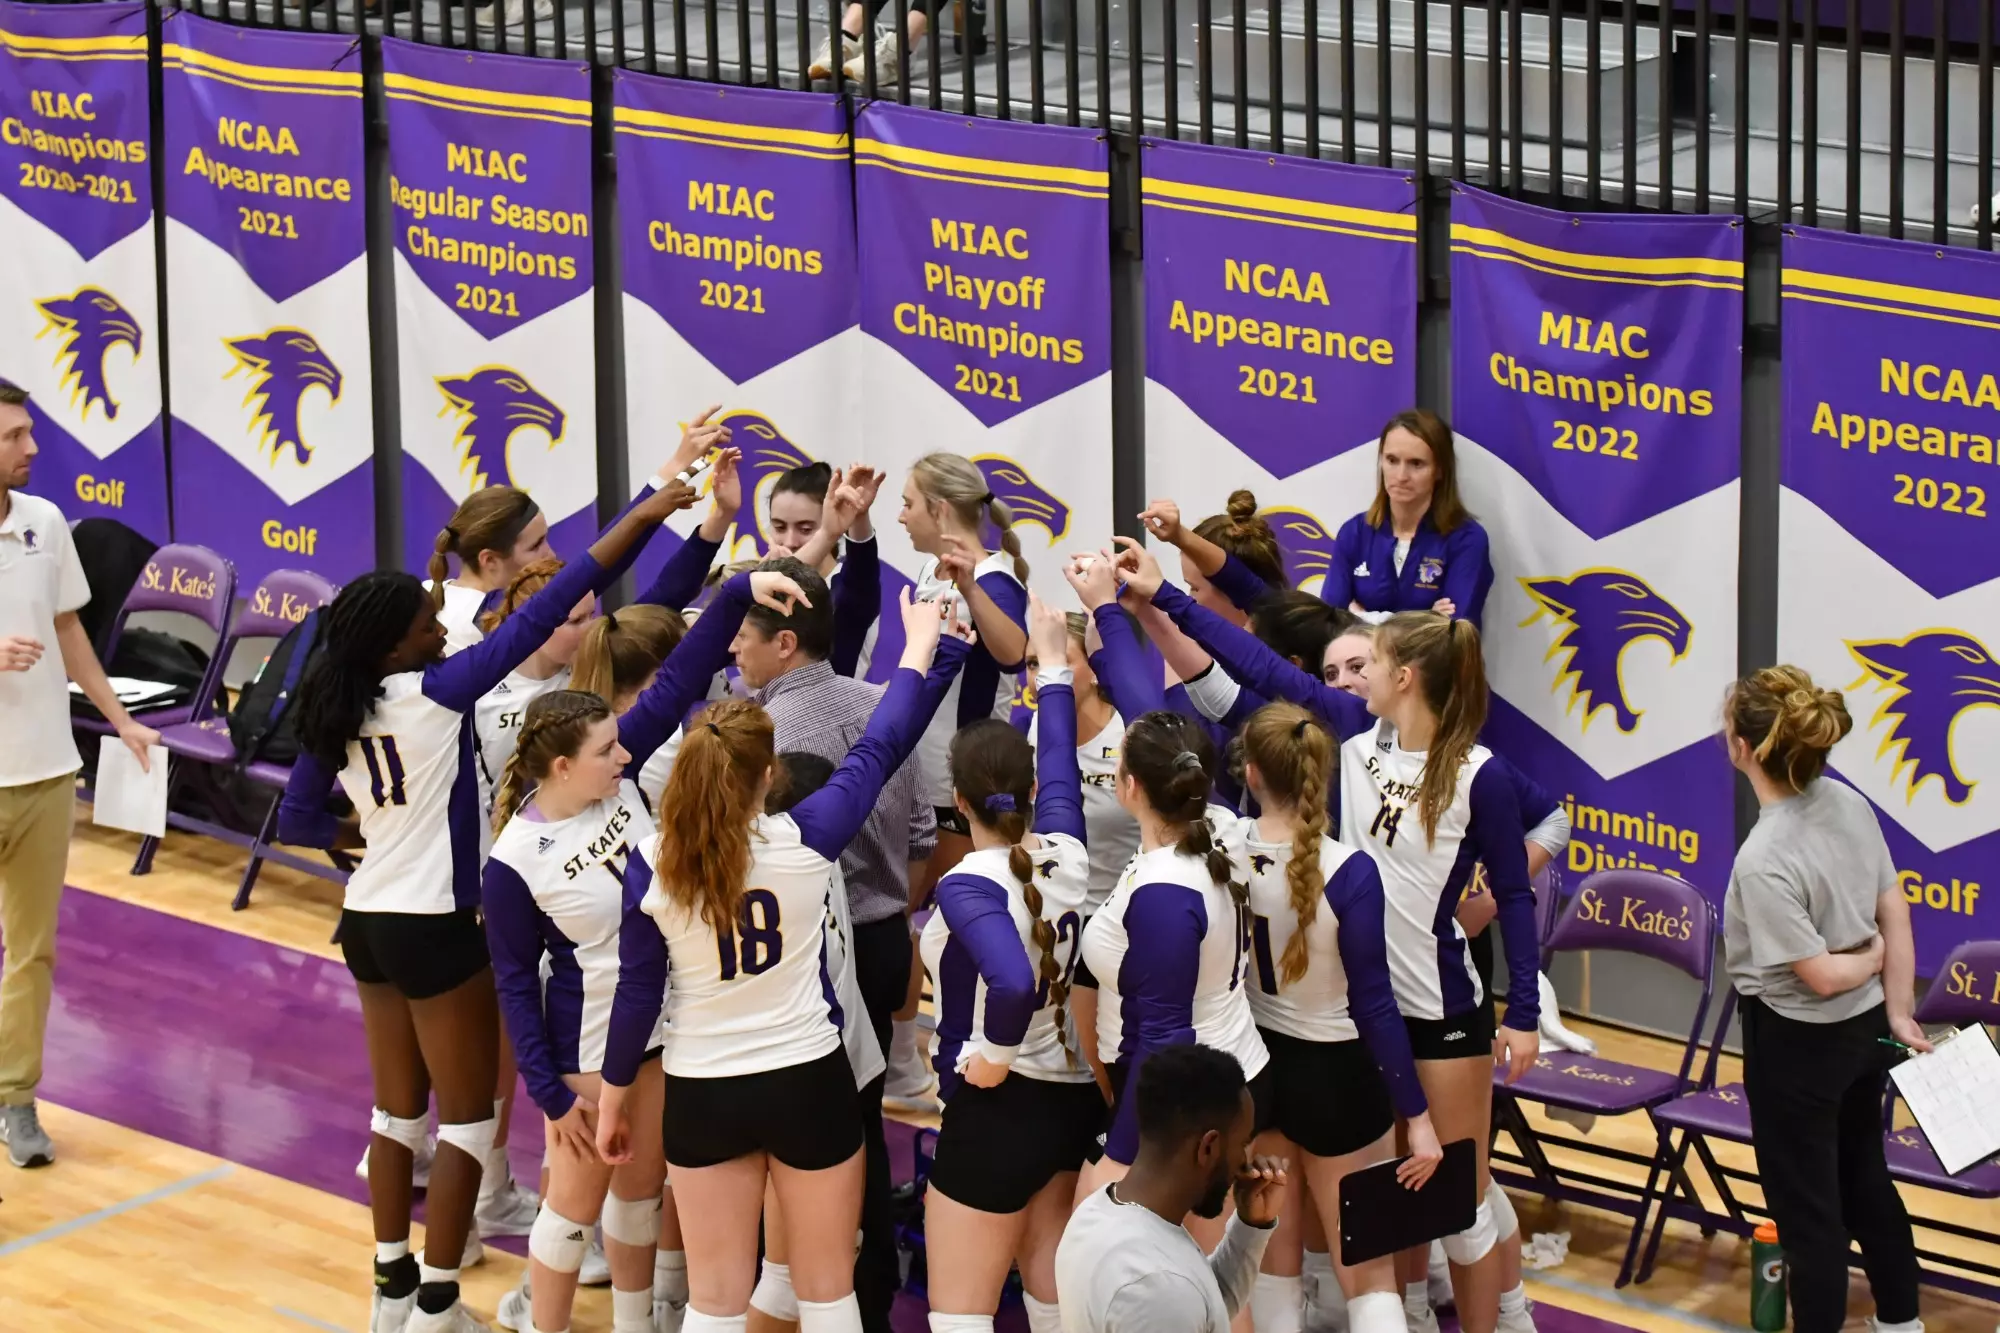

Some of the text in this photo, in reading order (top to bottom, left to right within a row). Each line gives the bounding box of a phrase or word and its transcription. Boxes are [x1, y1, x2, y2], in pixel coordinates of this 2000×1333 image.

[2, 116, 147, 164] Champions
[218, 116, 300, 156] NCAA
[19, 162, 137, 203] 2020-2021
[184, 146, 351, 202] Appearance
[447, 142, 527, 183] MIAC
[238, 206, 299, 239] 2021
[390, 175, 588, 236] Regular Season
[688, 180, 774, 221] MIAC
[408, 225, 577, 280] Champions
[649, 220, 822, 275] Champions
[931, 217, 1029, 260] MIAC
[456, 282, 520, 317] 2021
[699, 279, 765, 314] 2021
[924, 262, 1045, 310] Playoff
[1225, 258, 1330, 306] NCAA
[894, 303, 1084, 364] Champions
[1169, 300, 1394, 365] Appearance
[1539, 311, 1650, 360] MIAC
[955, 364, 1022, 402] 2021
[1239, 366, 1317, 403] 2021
[1490, 351, 1713, 417] Champions
[1880, 358, 2000, 411] NCAA
[1552, 420, 1639, 460] 2022
[1812, 402, 2000, 465] Appeara
[75, 474, 125, 507] Golf
[1893, 473, 1987, 517] 2022
[262, 519, 317, 556] Golf
[142, 562, 216, 599] St. Kate's
[251, 586, 275, 617] St.
[499, 712, 522, 729] ST.
[563, 805, 632, 880] ST. KATE'S
[1557, 793, 1699, 864] imming
[1577, 888, 1693, 940] St. Kate's
[1897, 869, 1981, 916] Golf
[1946, 961, 1982, 1001] St.
